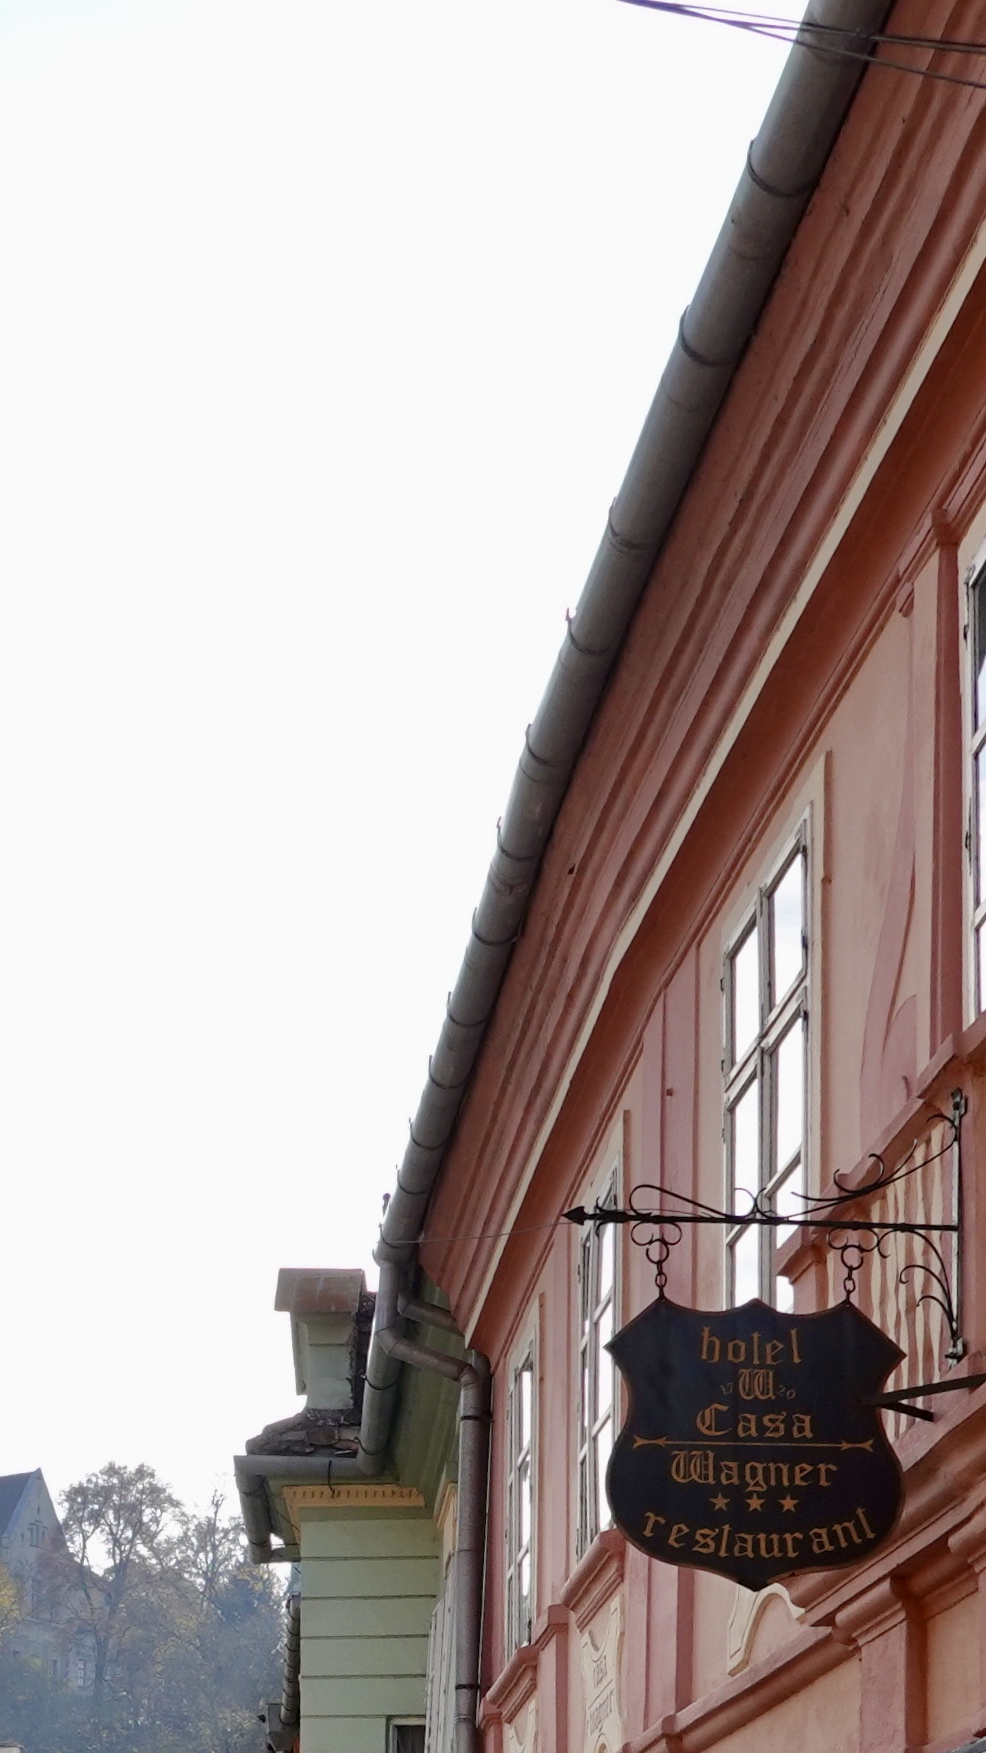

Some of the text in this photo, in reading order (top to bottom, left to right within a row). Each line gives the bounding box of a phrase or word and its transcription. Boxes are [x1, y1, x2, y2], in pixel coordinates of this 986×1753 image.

[700, 1326, 803, 1366] hotel
[695, 1403, 813, 1439] Casa
[670, 1449, 837, 1493] Wagner
[642, 1506, 876, 1559] restaurant
